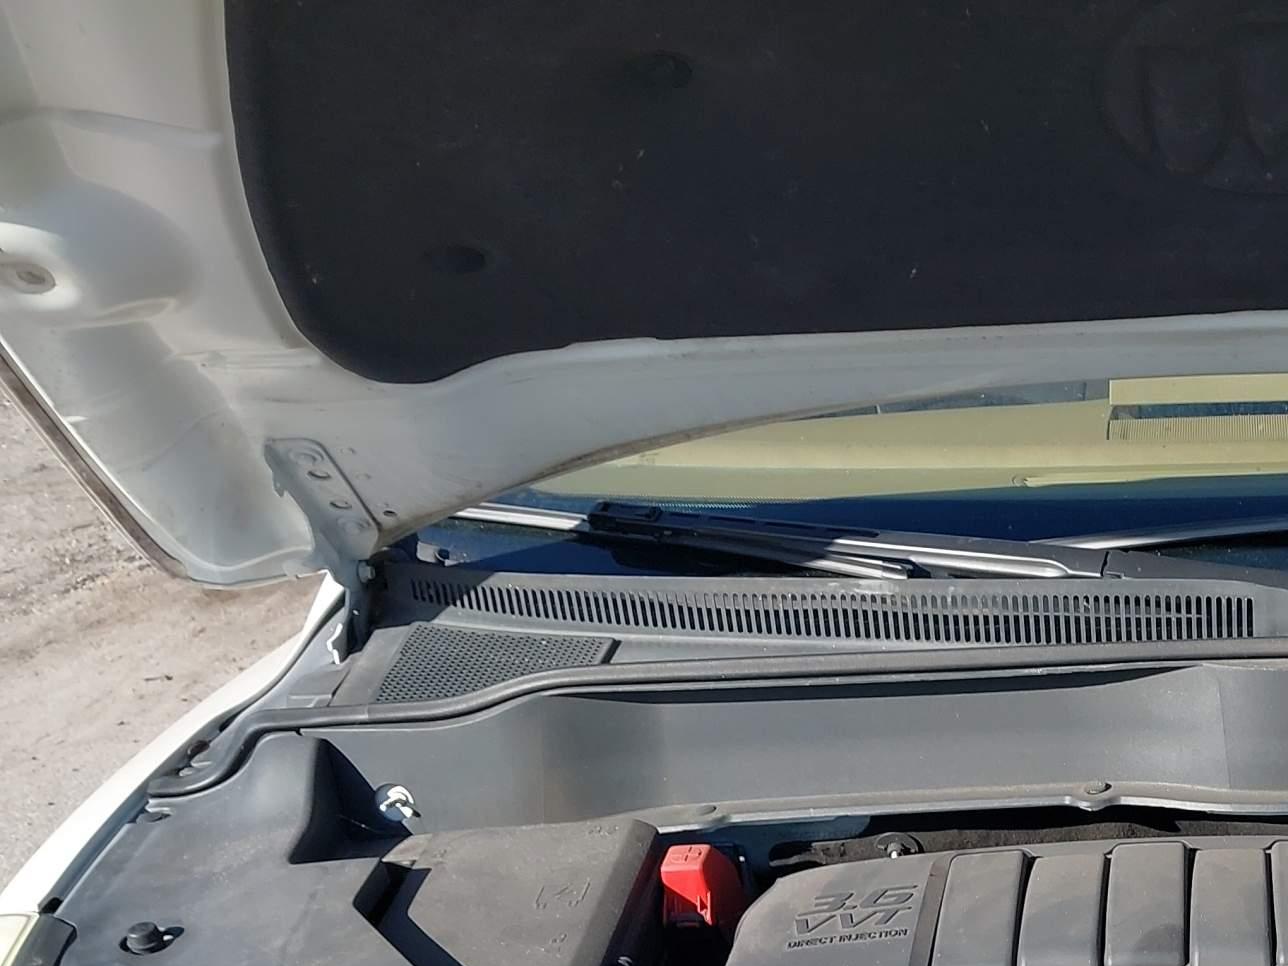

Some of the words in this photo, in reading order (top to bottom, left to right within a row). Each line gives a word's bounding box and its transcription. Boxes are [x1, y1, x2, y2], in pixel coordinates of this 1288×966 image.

[797, 885, 918, 917] 3.6
[795, 906, 913, 934] VVT
[787, 937, 837, 950] DIRECT
[838, 928, 908, 943] INJECTION
